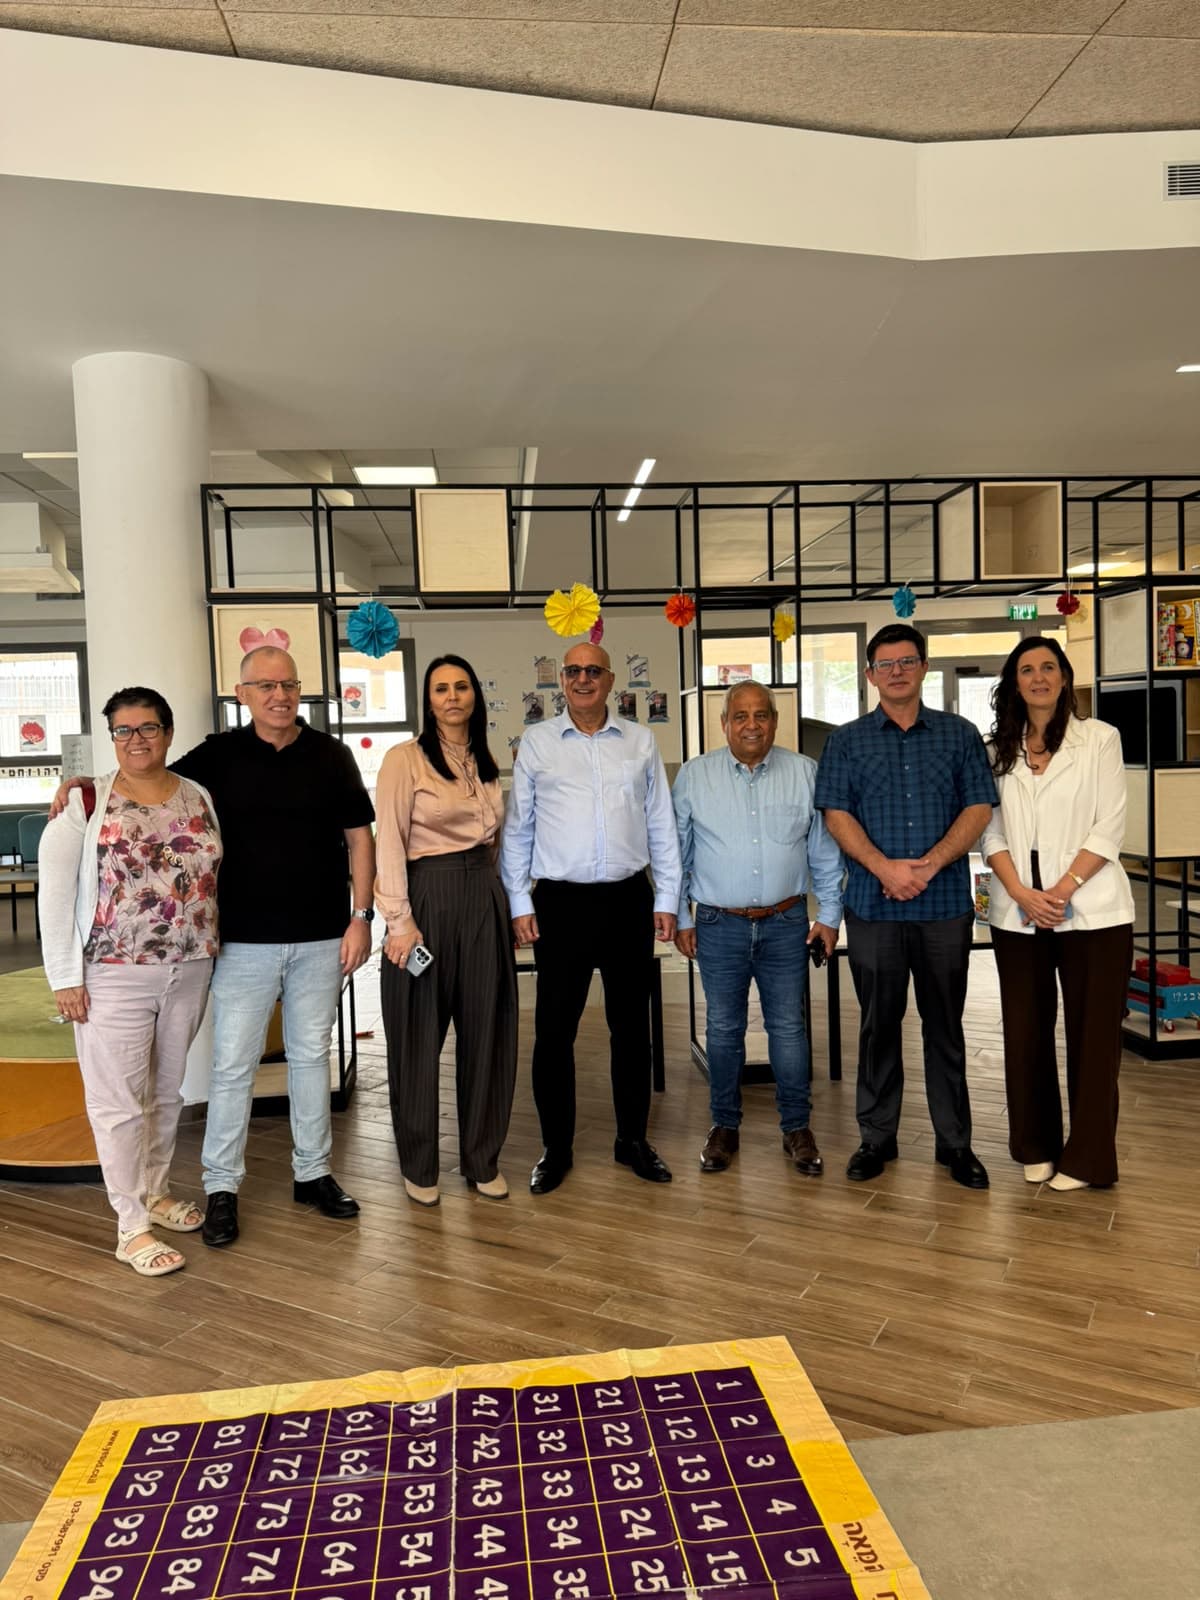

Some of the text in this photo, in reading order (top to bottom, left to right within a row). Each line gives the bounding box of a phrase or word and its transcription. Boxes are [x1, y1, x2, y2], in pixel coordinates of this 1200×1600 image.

[594, 1386, 624, 1409] 21
[654, 1381, 684, 1403] 11
[716, 1380, 742, 1391] 1
[409, 1401, 437, 1428] 51
[472, 1394, 499, 1417] 41
[532, 1392, 562, 1415] 31
[279, 1416, 311, 1441] 71
[344, 1410, 375, 1435] 61
[602, 1422, 633, 1447] 22
[665, 1416, 697, 1441] 12
[730, 1414, 759, 1428] 2
[145, 1430, 181, 1456] 91
[213, 1424, 246, 1449] 81
[472, 1432, 501, 1463] 42
[537, 1429, 567, 1454] 32
[268, 1454, 302, 1482] 72
[339, 1448, 370, 1478] 62
[407, 1440, 437, 1470] 52
[677, 1454, 711, 1483] 13
[746, 1454, 776, 1468] 3
[125, 1469, 164, 1499] 92
[197, 1462, 234, 1492] 82
[541, 1469, 574, 1499] 33
[610, 1462, 644, 1491] 23
[403, 1483, 436, 1515] 53
[472, 1477, 503, 1507] 43
[766, 1498, 797, 1515] 4
[181, 1504, 219, 1540] 83
[255, 1498, 293, 1530] 73
[330, 1493, 364, 1523] 63
[690, 1500, 729, 1532] 14
[104, 1513, 145, 1548] 93
[546, 1516, 582, 1550] 34
[620, 1507, 657, 1540] 24
[399, 1531, 434, 1568] 54
[473, 1523, 506, 1559] 44
[241, 1547, 281, 1584] 74
[321, 1541, 357, 1577] 64
[706, 1550, 748, 1584] 15
[784, 1547, 821, 1567] 5
[78, 1565, 124, 1600] 94
[160, 1558, 203, 1595] 84
[474, 1577, 509, 1600] 4
[631, 1558, 671, 1594] 25
